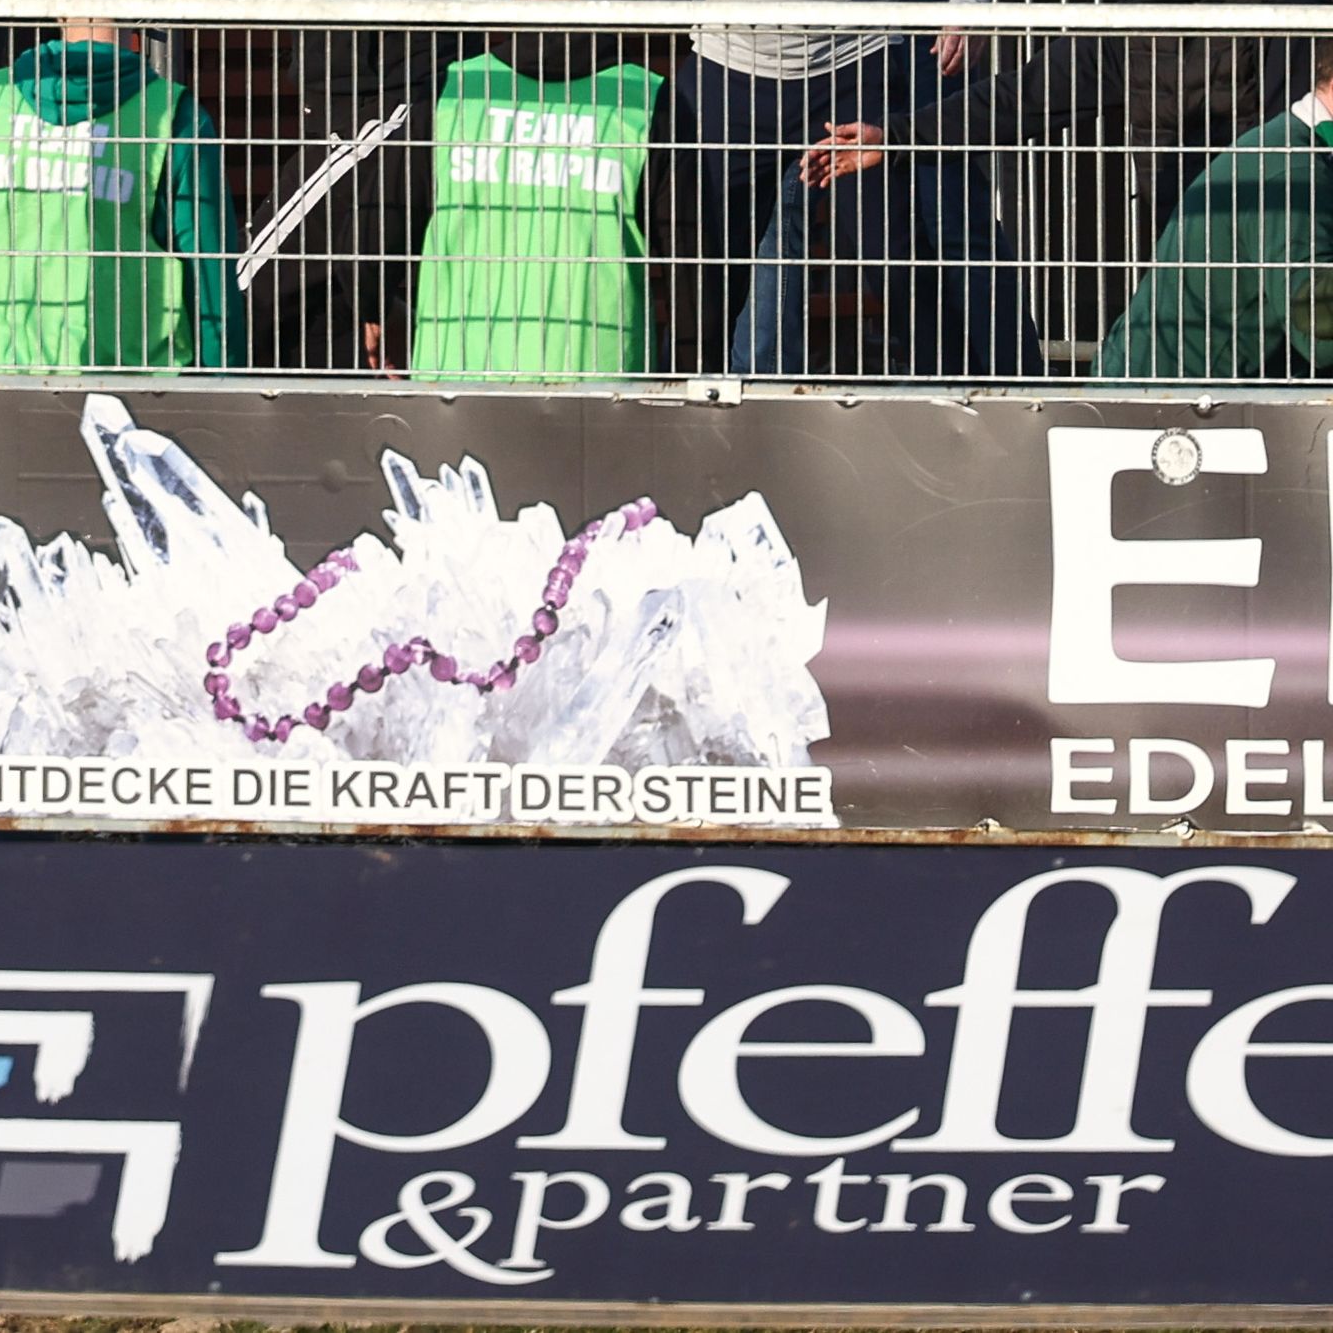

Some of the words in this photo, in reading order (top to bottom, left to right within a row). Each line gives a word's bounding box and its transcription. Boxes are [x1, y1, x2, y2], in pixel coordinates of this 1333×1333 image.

[489, 106, 595, 151] TEAM
[25, 155, 133, 204] RAPID
[451, 146, 501, 183] SK
[507, 150, 623, 194] RAPID
[1047, 426, 1333, 708] E
[232, 768, 311, 807] DIE
[332, 770, 502, 810] KRAFT
[520, 773, 623, 813] DER
[642, 774, 824, 815] STEINE
[215, 864, 1333, 1268] pfeffe
